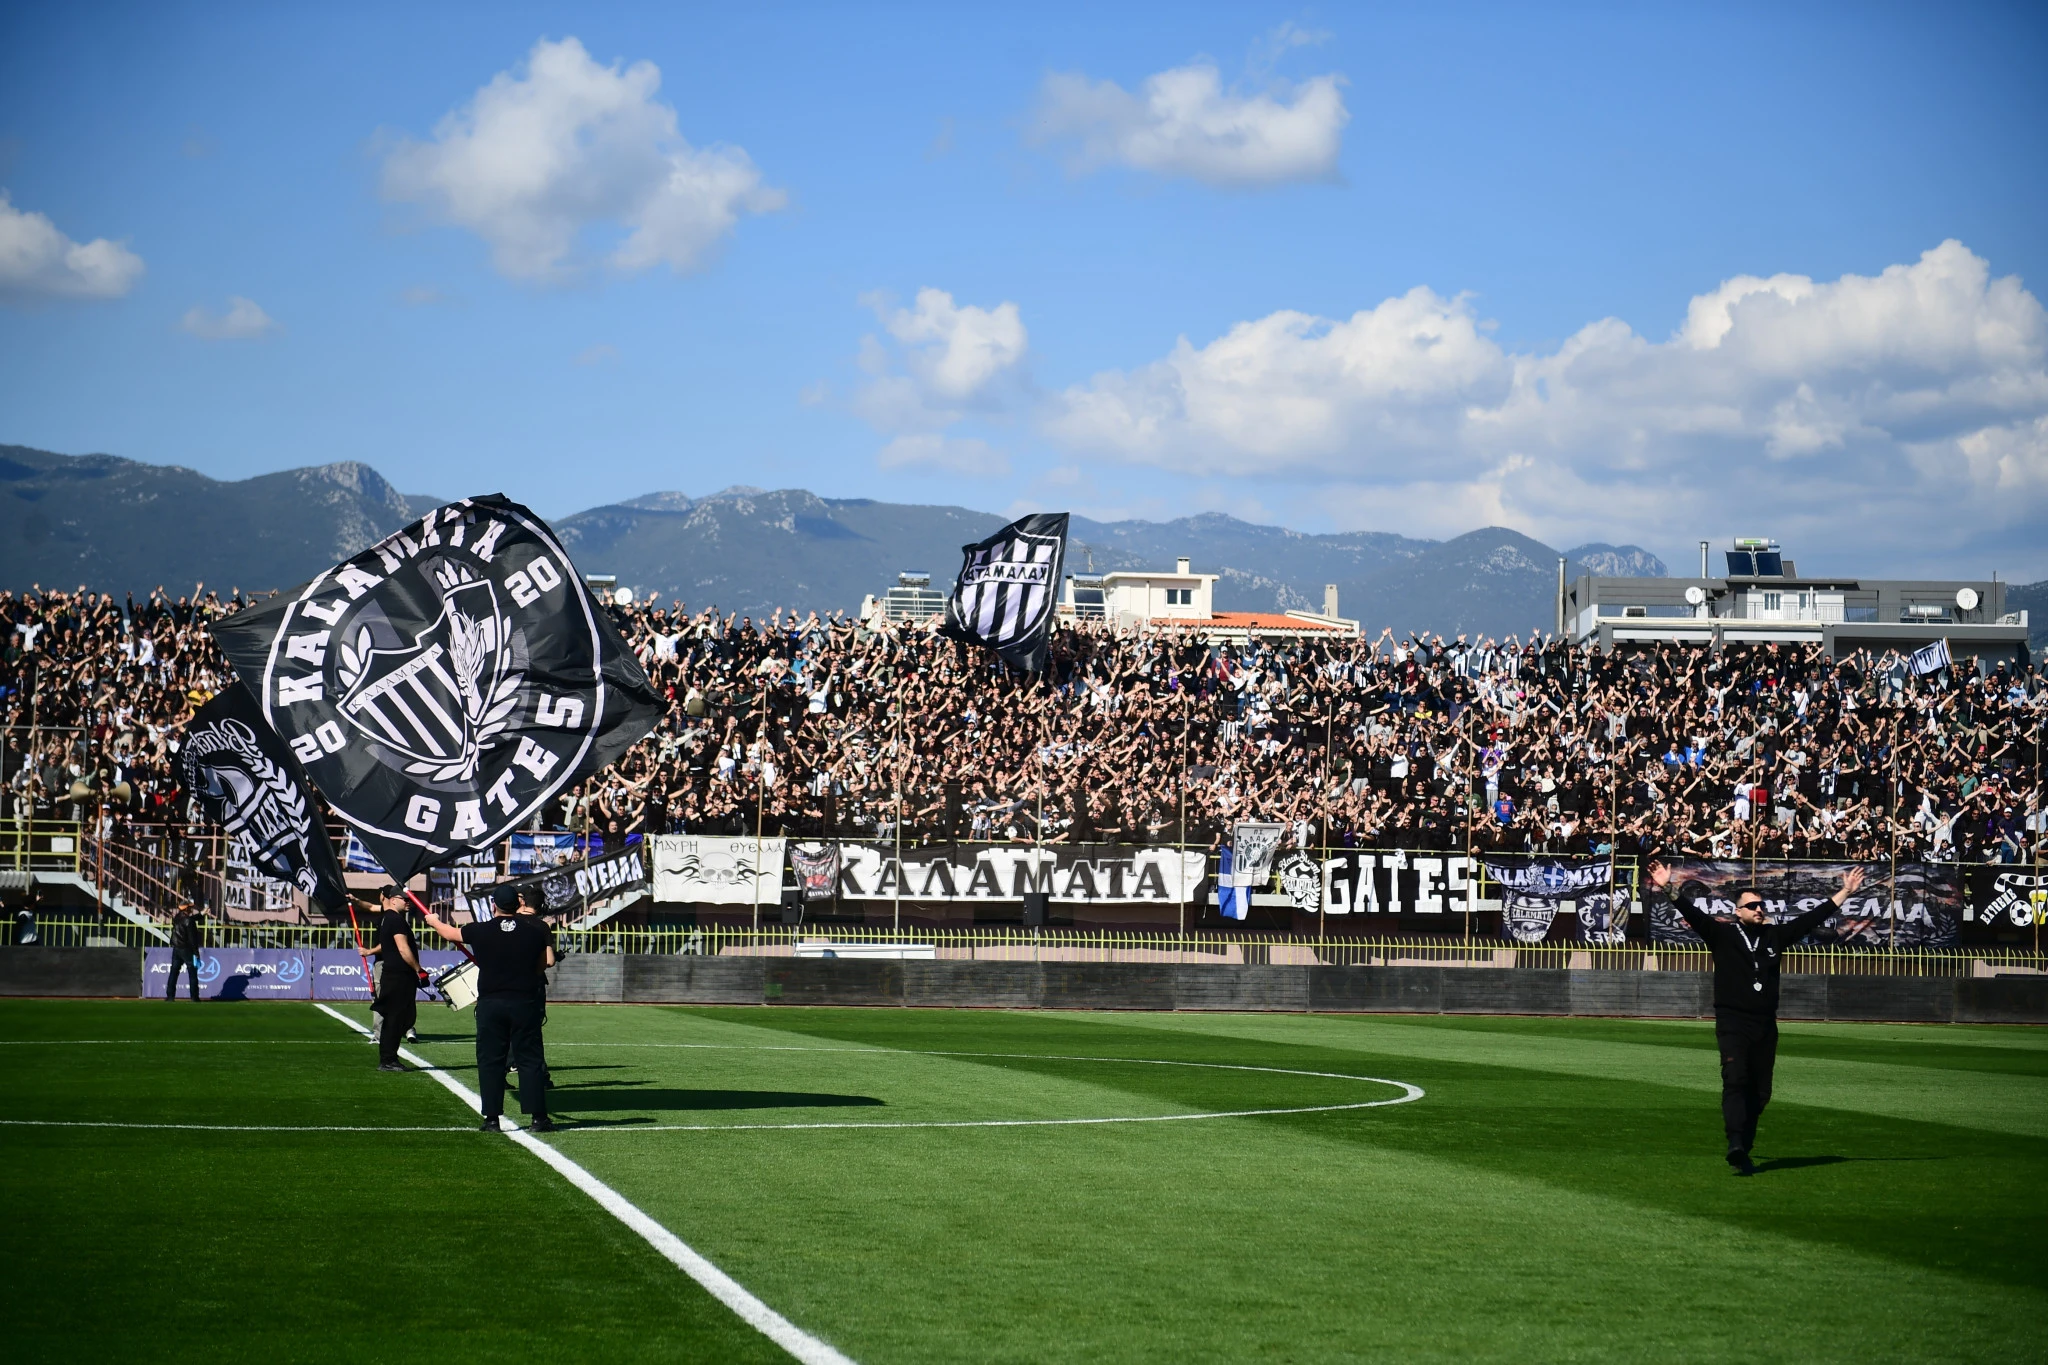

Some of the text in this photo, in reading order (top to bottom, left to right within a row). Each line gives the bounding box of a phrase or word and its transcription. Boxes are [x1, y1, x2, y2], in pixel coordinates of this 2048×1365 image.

[504, 556, 561, 609] 20
[279, 505, 506, 706] KALAMATA
[289, 720, 347, 764] 20
[575, 852, 643, 897] ΘΥΕΛΛΑ
[839, 857, 1170, 898] ΚΑΛΑΜΑΤΑ
[1793, 897, 1937, 929] ΘΕΛΛΑ
[1980, 888, 2017, 925] EXTREME
[235, 960, 300, 976] ACTION 24
[319, 965, 361, 976] ACTION
